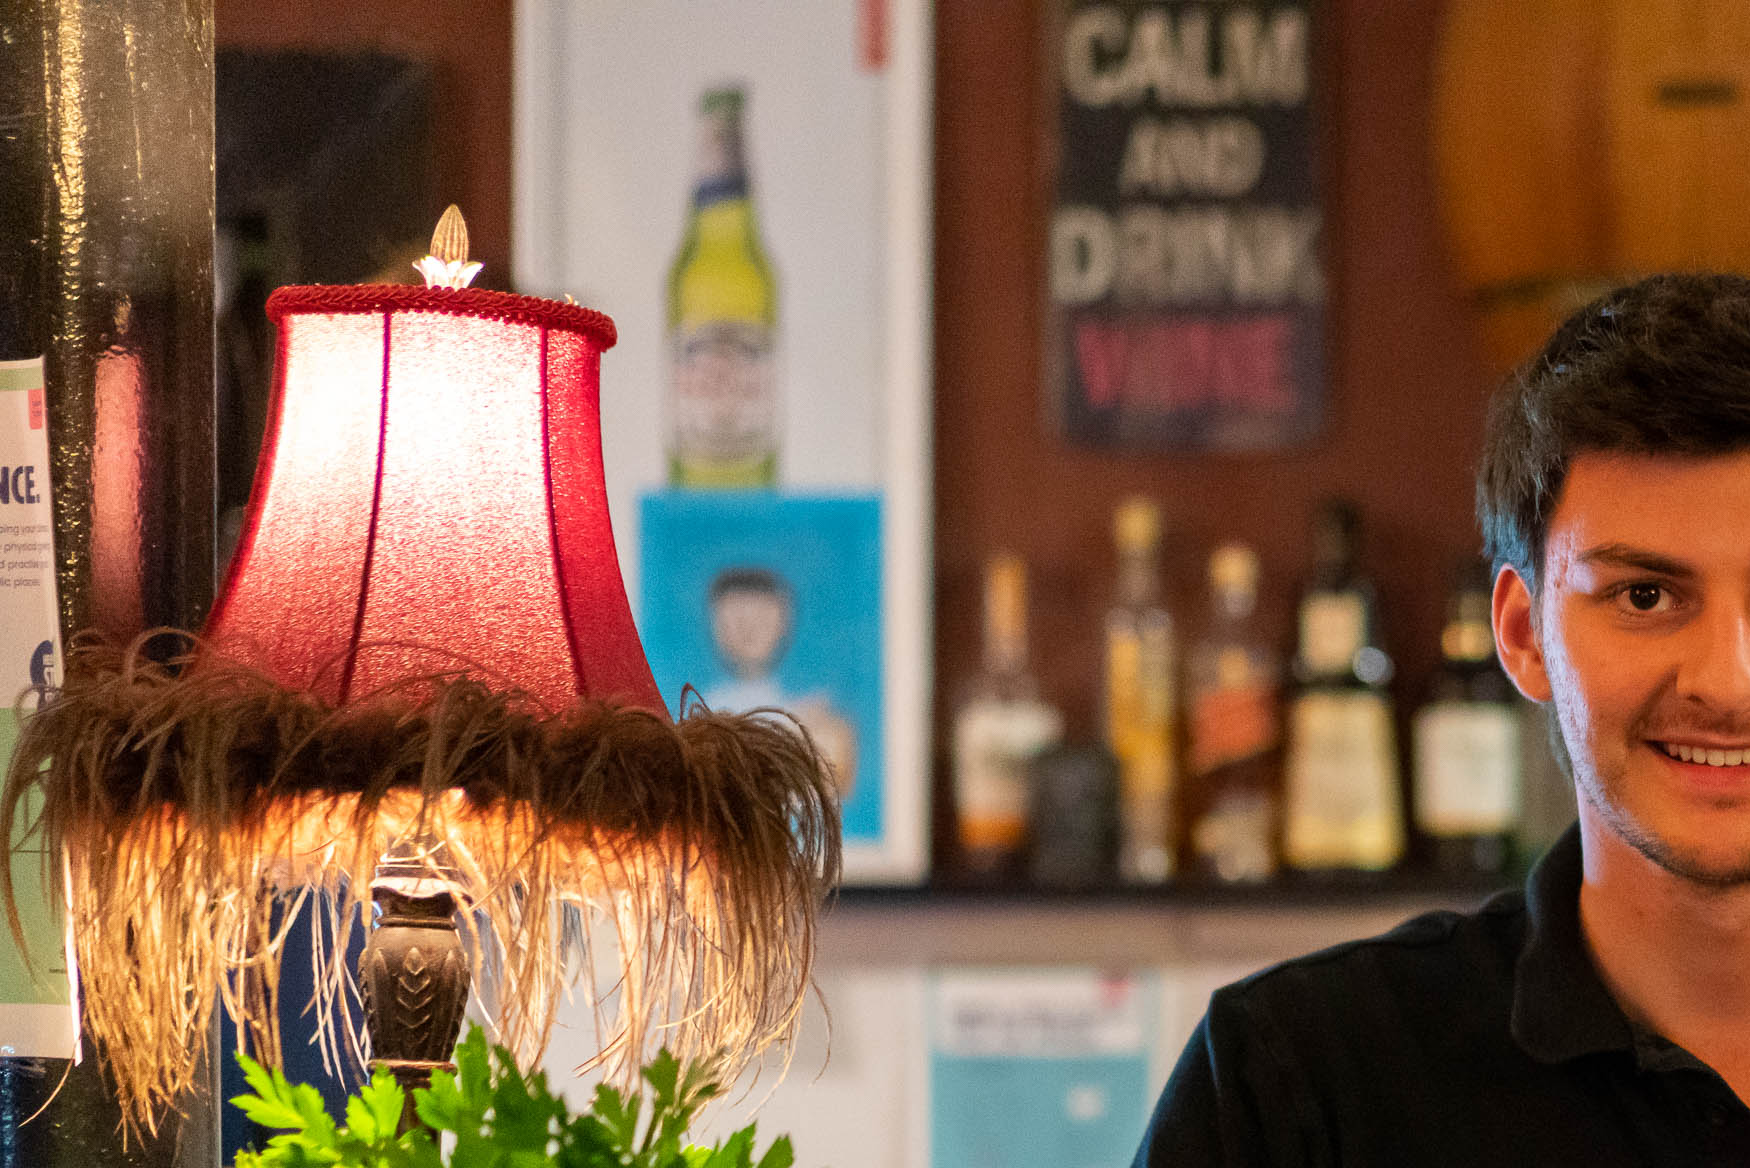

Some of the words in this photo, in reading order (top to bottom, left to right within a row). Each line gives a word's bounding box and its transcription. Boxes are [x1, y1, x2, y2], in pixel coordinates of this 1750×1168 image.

[1066, 9, 1308, 105] CALM
[1120, 116, 1263, 197] AND
[1053, 207, 1326, 304] DRINK
